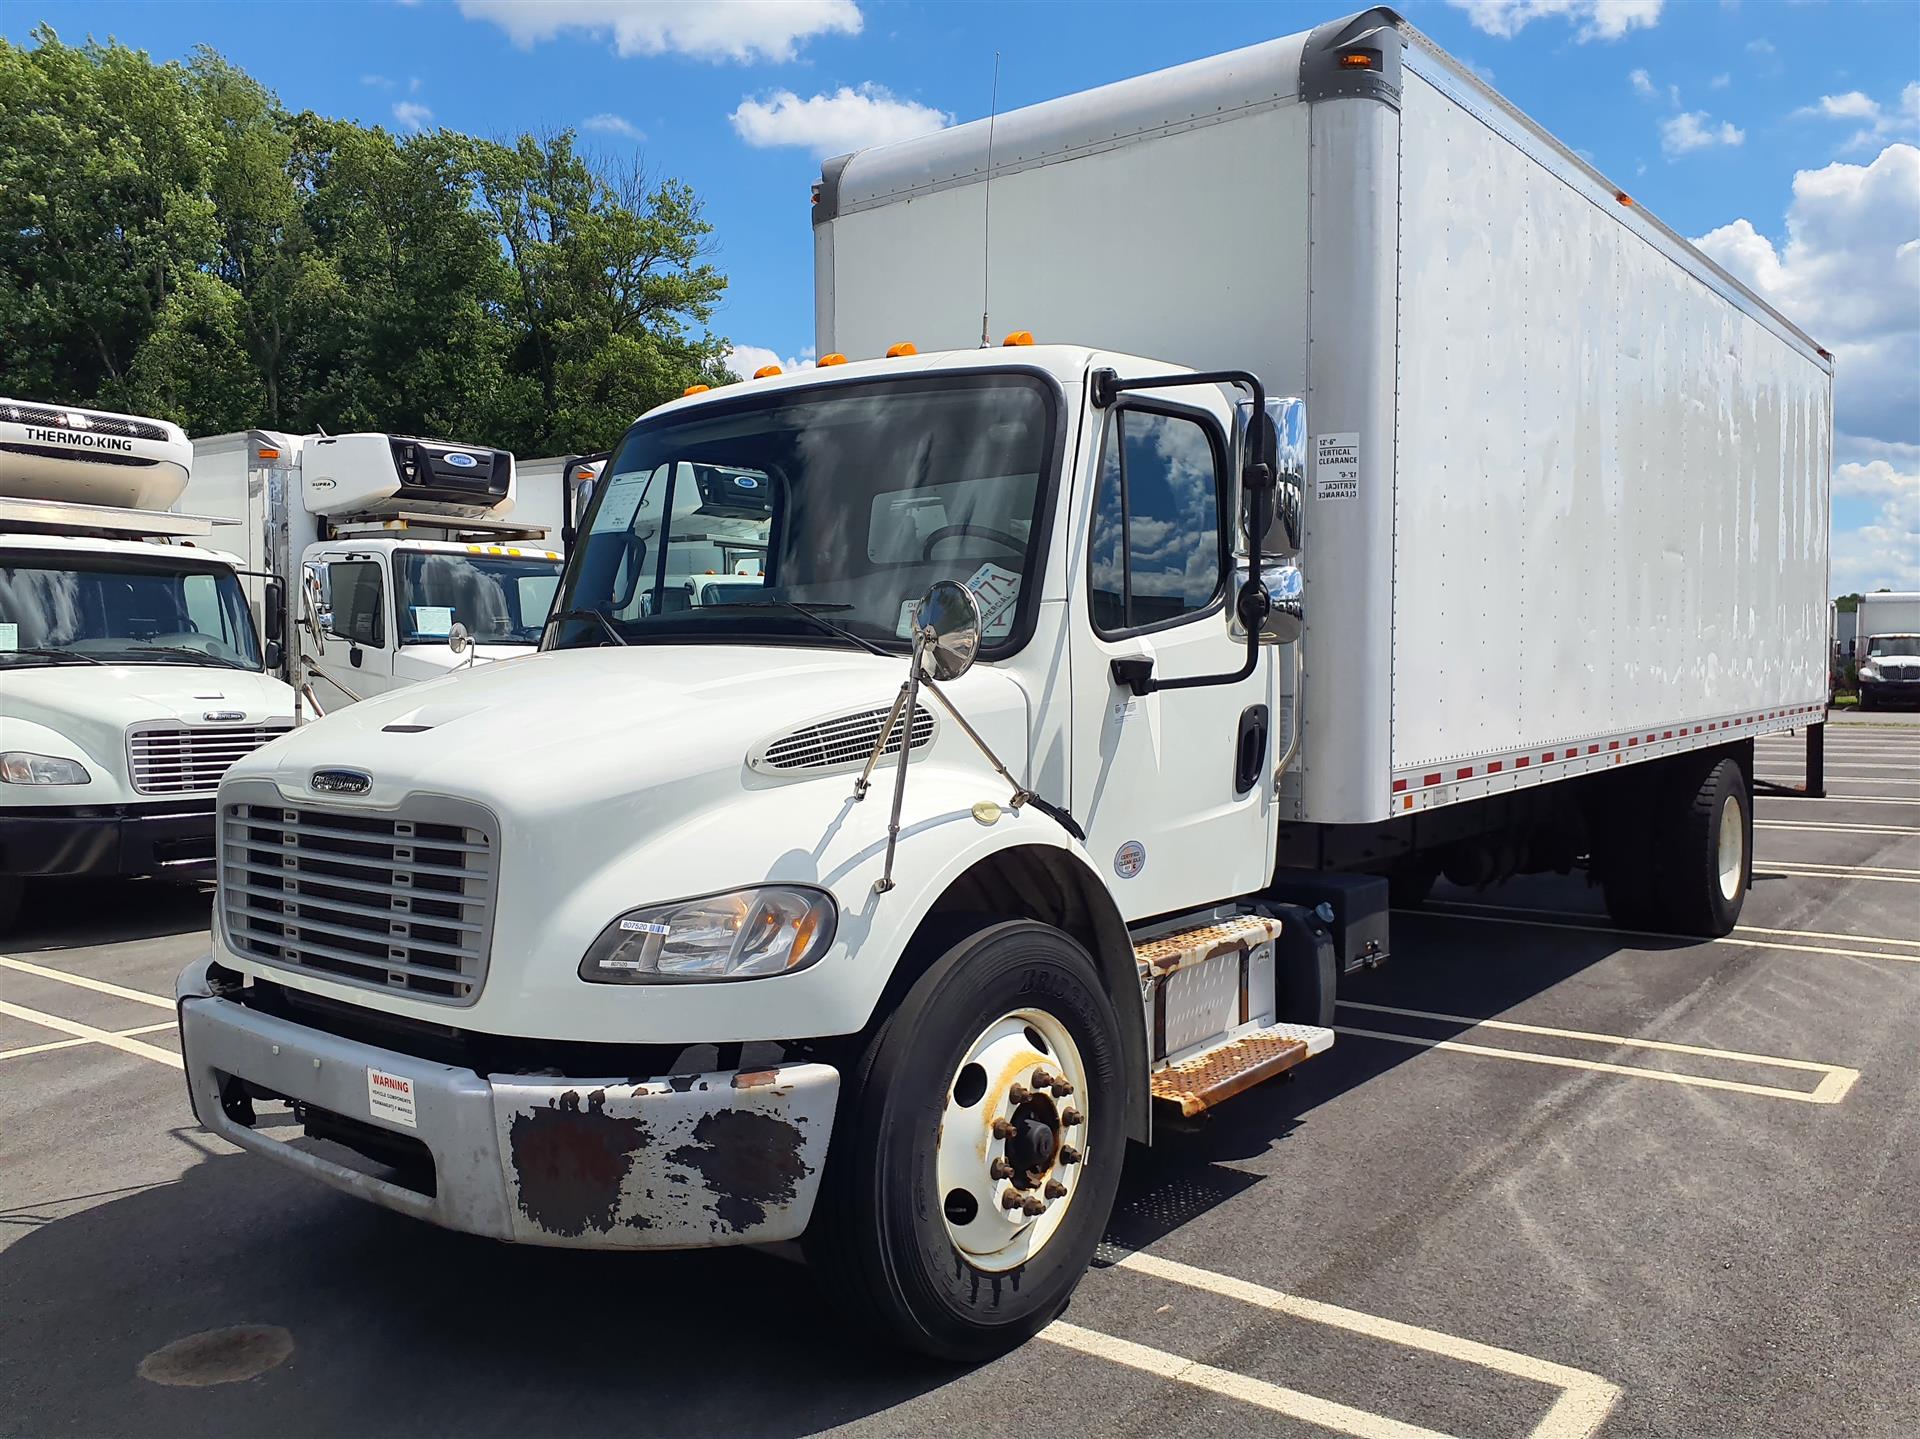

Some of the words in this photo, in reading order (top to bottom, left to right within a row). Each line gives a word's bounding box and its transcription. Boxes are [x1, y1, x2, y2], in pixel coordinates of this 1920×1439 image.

[26, 428, 94, 446] THERMO
[97, 437, 132, 451] KING
[1319, 449, 1351, 457] VERTICAL
[1318, 457, 1358, 465] CLEARANCE
[622, 923, 647, 931] 807520
[372, 1073, 409, 1093] WARNING
